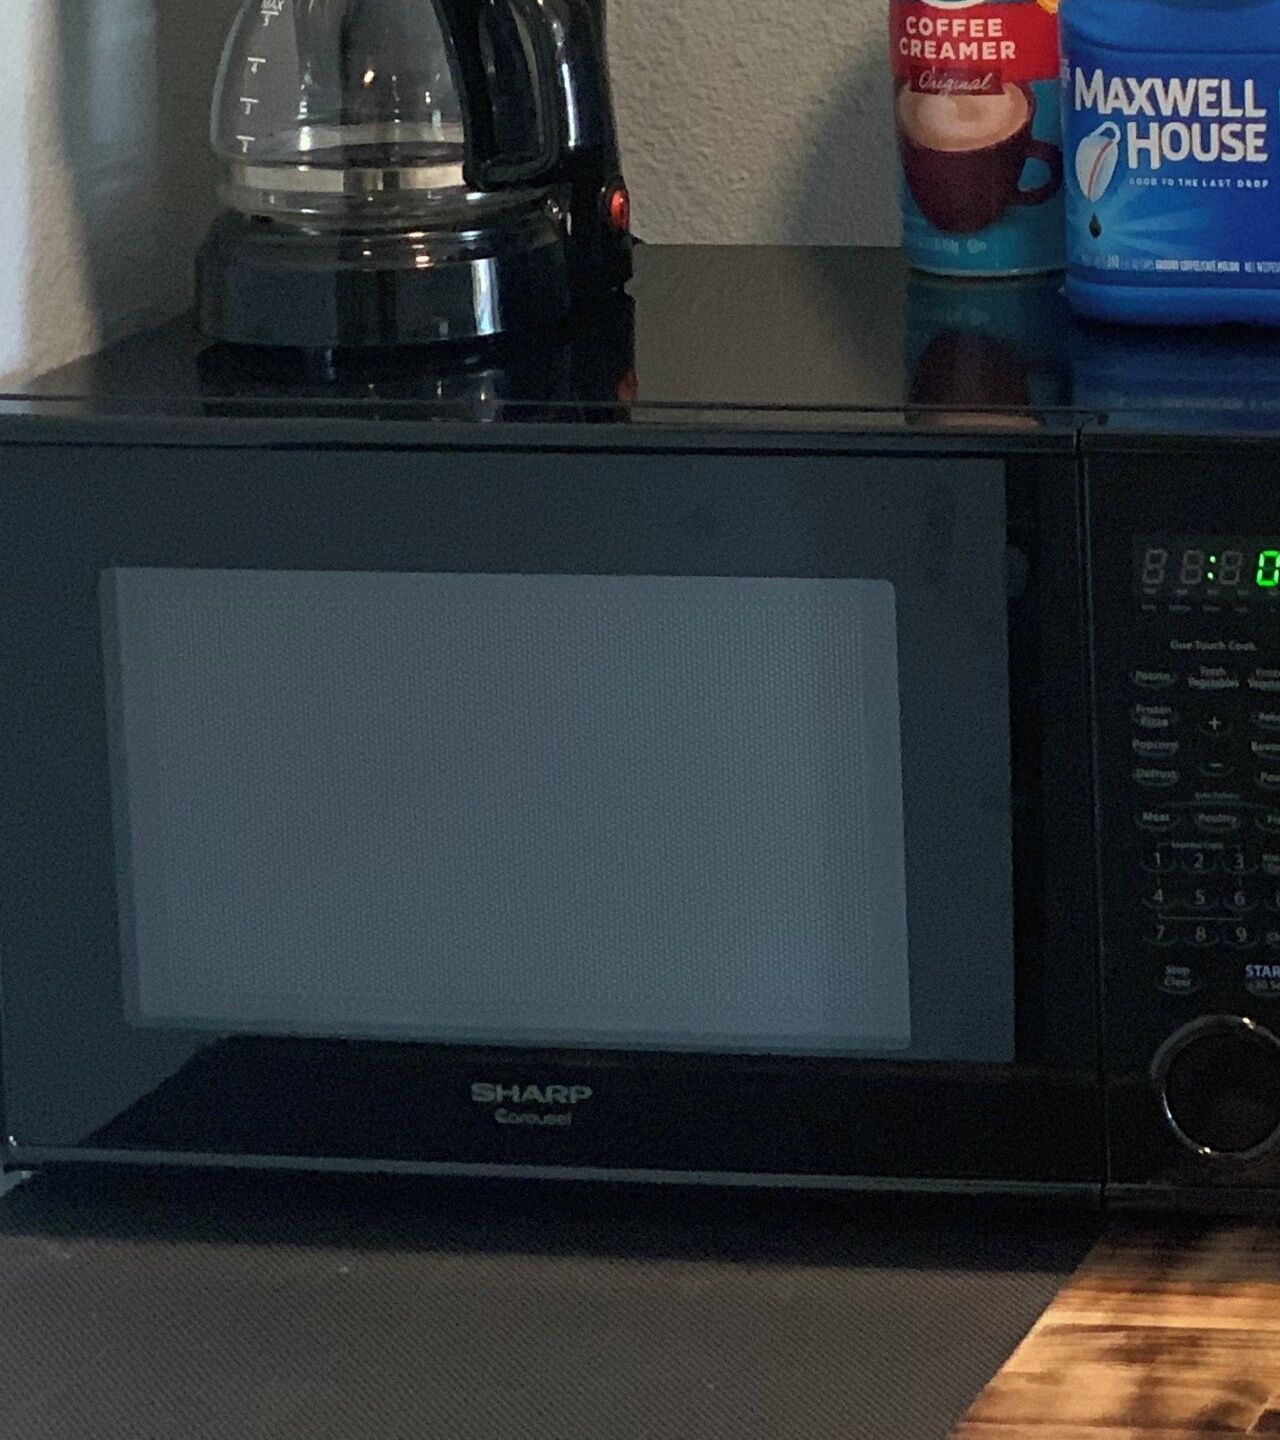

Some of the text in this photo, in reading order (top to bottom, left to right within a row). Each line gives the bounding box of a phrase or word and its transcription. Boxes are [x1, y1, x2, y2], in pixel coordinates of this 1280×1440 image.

[905, 15, 1004, 38] COFFEE
[898, 37, 1016, 61] CREAMER
[250, 62, 259, 75] 4
[917, 69, 993, 94] Original
[1074, 66, 1267, 118] MAXWELL
[1126, 120, 1269, 170] HOUSE
[1178, 178, 1198, 188] THE
[1202, 179, 1231, 188] LAST
[1236, 179, 1269, 189] DROP
[1193, 852, 1205, 869] 2
[1234, 853, 1245, 870] 3
[1153, 888, 1164, 903] 4
[1195, 888, 1206, 905] 5
[1234, 891, 1246, 906] 6
[1155, 924, 1165, 940] 7
[1195, 926, 1207, 942] 8
[1235, 926, 1248, 942] 9
[471, 1082, 593, 1104] SHARP
